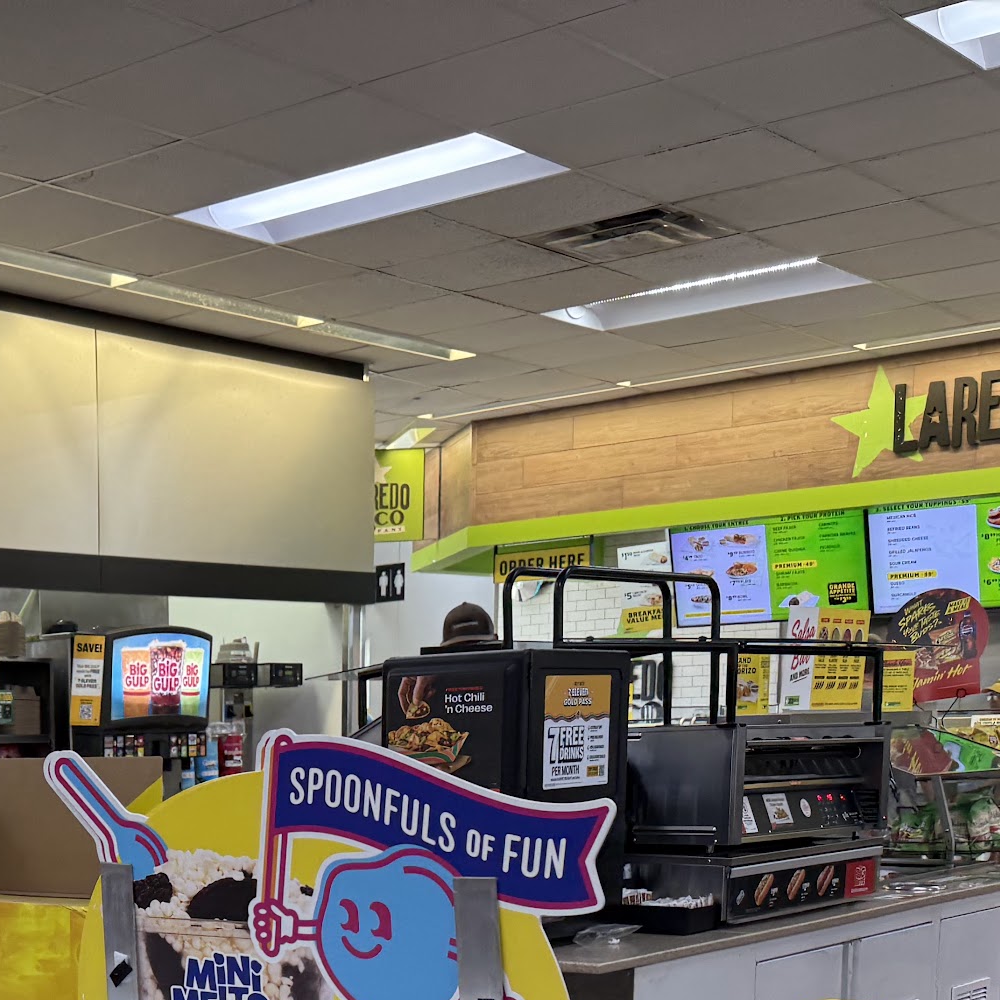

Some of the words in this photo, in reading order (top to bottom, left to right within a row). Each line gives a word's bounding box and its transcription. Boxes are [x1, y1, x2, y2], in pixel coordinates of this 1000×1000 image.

[907, 502, 921, 510] YOUR
[819, 510, 845, 518] PROTEIN
[774, 561, 803, 570] PREMIUM
[889, 572, 920, 580] PREMIUM
[626, 614, 649, 624] VALUE
[898, 602, 937, 632] SPARKS
[76, 643, 103, 653] SAVE!
[947, 663, 973, 680] Hot
[125, 675, 149, 687] GULP
[153, 677, 180, 692] GULP
[182, 676, 200, 687] GULP
[444, 693, 462, 704] Hot
[463, 691, 485, 702] Chili
[563, 698, 579, 707] GOLD
[578, 697, 593, 706] PASS
[454, 703, 494, 714] Cheese
[547, 725, 561, 765] 7
[559, 725, 585, 747] FREE
[558, 745, 585, 763] DRINKS
[551, 765, 561, 777] PER
[561, 763, 580, 776] MONTH
[289, 766, 457, 853] SPOONFULS
[465, 829, 496, 862] OF
[502, 833, 567, 880] FUN
